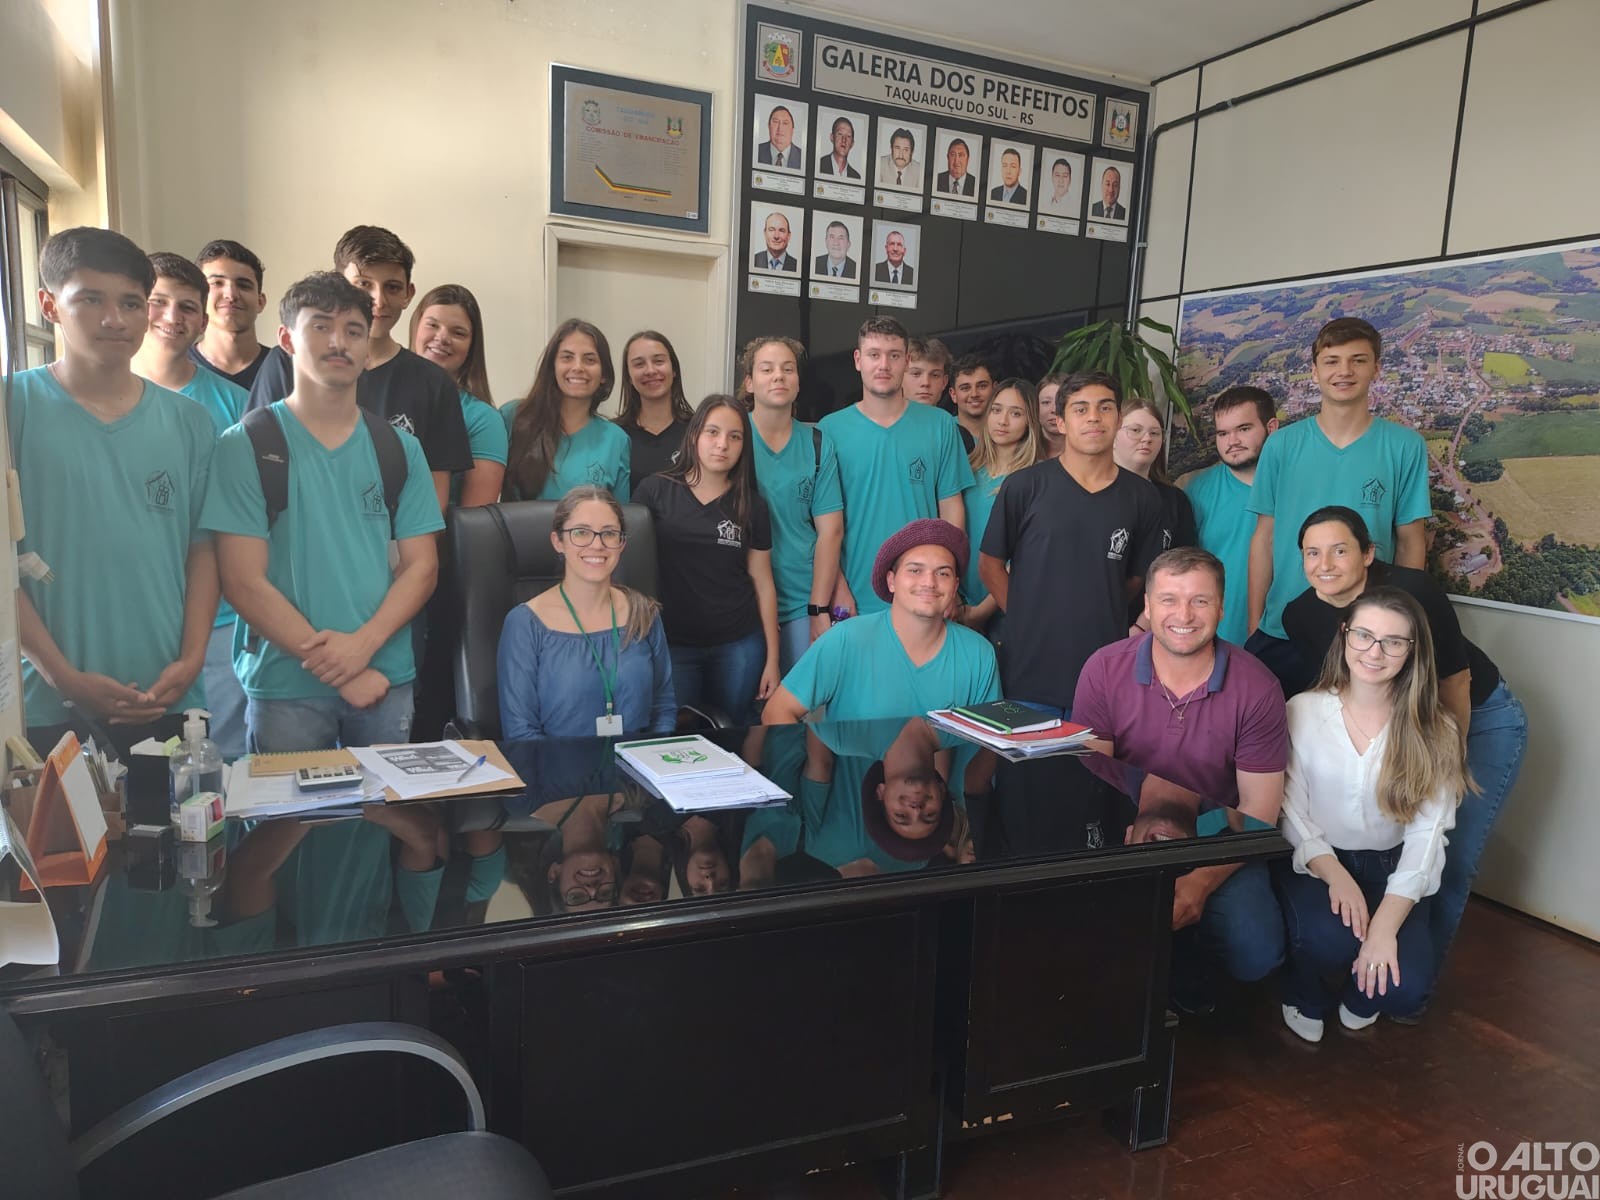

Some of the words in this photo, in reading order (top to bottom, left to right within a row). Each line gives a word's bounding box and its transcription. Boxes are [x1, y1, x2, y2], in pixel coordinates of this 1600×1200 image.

[821, 44, 922, 86] GALERIA
[930, 66, 976, 96] DOS
[982, 77, 1089, 119] PREFEITOS
[884, 84, 963, 113] TAQUARUÇU
[966, 101, 984, 115] DO
[987, 105, 1009, 120] SUL
[1019, 112, 1034, 126] RS
[623, 131, 632, 139] DE
